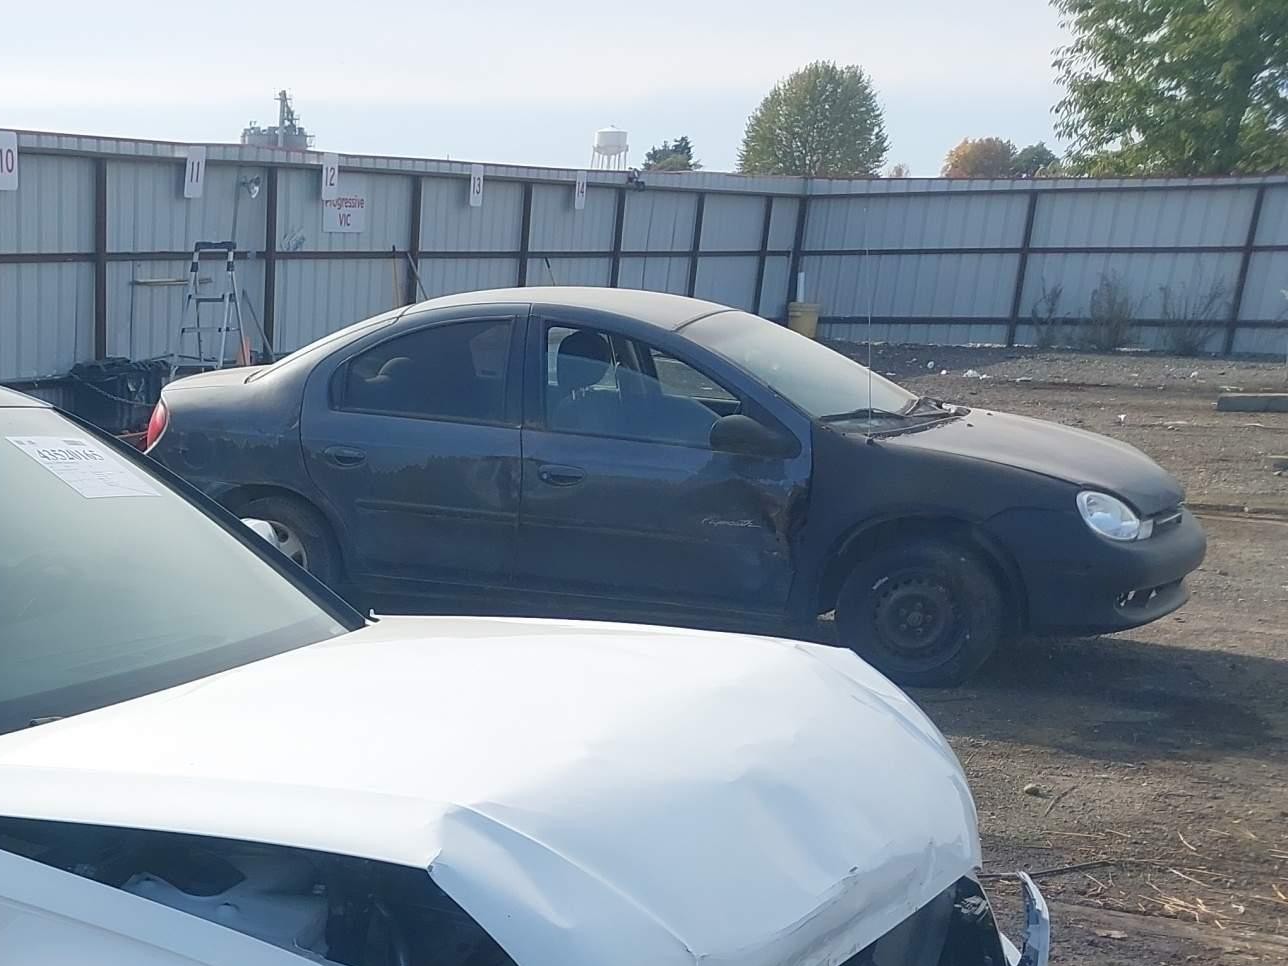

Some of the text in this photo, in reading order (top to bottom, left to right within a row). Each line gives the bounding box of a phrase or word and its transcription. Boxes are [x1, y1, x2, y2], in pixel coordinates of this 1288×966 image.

[190, 160, 200, 183] 11
[325, 167, 336, 187] 12
[472, 176, 481, 195] 13
[576, 181, 585, 198] 14
[338, 213, 352, 227] VIC
[36, 449, 105, 461] 43520165
